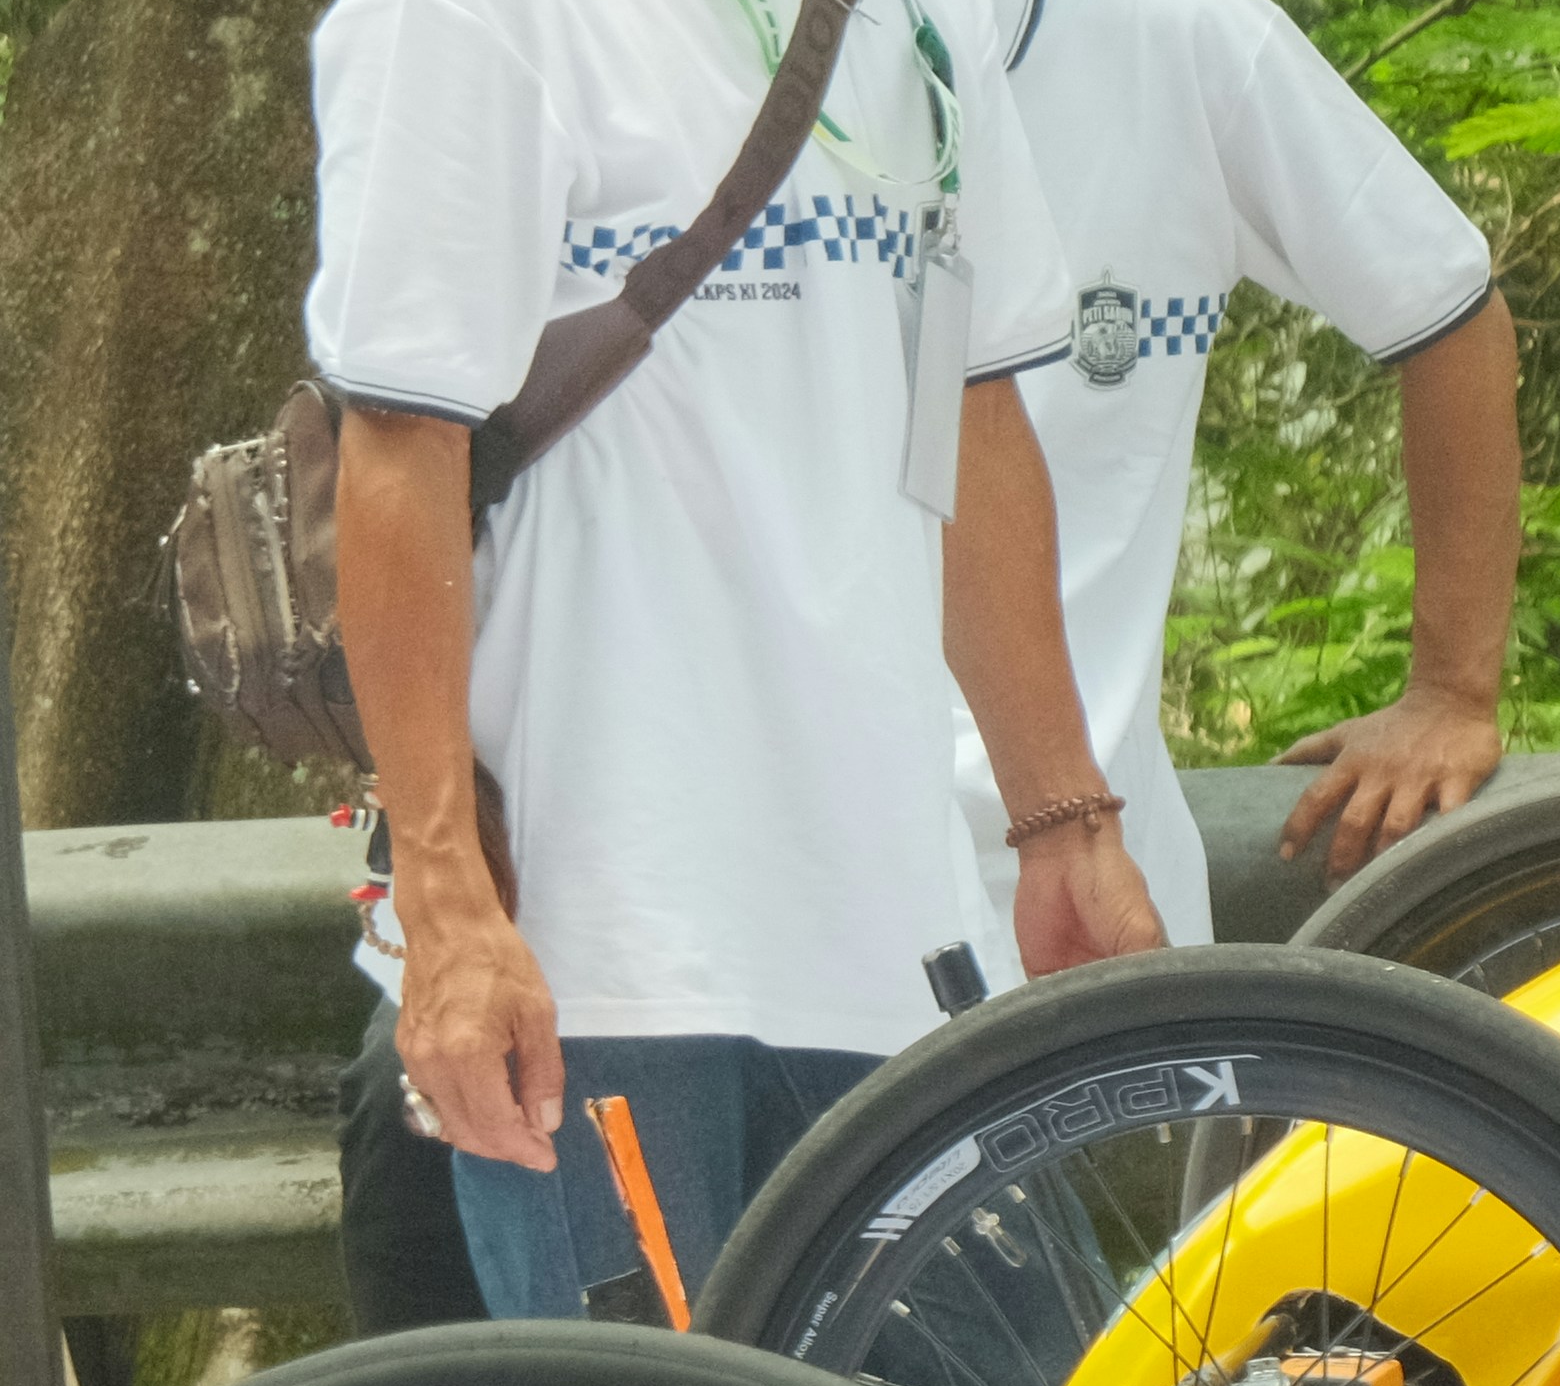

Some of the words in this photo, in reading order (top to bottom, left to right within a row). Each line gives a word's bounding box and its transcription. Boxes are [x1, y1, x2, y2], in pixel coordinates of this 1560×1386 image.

[761, 282, 801, 301] 2024
[809, 1291, 838, 1328] Super
[794, 1326, 817, 1360] Alloy
